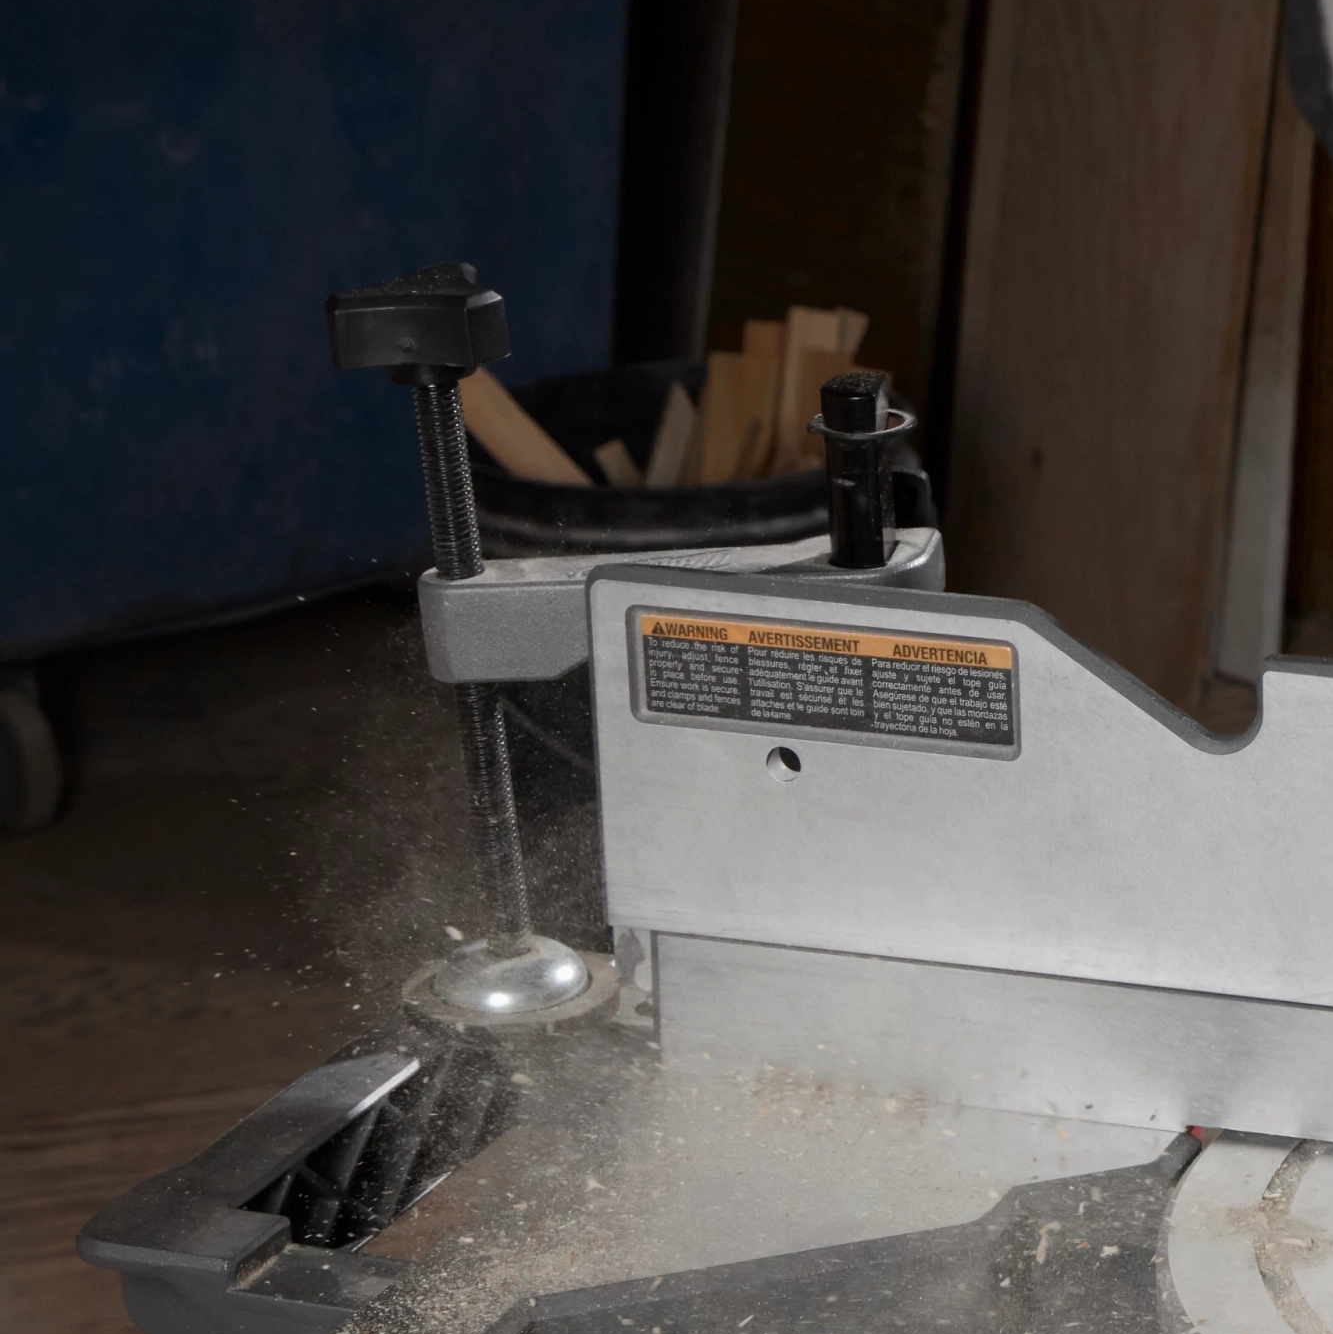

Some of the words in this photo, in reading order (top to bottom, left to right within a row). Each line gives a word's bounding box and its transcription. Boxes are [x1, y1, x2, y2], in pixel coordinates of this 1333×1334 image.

[665, 623, 728, 640] WARNING
[647, 637, 657, 646] To
[662, 639, 689, 649] reduce
[694, 641, 707, 650] the
[712, 643, 726, 652] risk
[730, 645, 739, 653] of
[748, 631, 859, 653] AVERTISSEMENT
[682, 651, 708, 662] adjust
[715, 654, 739, 664] fence
[748, 647, 767, 656] Pour
[771, 649, 799, 659] réduire
[803, 652, 815, 661] les
[818, 654, 848, 664] risques
[851, 656, 862, 665] de
[893, 644, 987, 665] ADVERTENCIA
[649, 660, 682, 671] properly
[689, 662, 704, 671] and
[712, 665, 739, 674] secure
[749, 657, 791, 670] blessures,
[798, 662, 822, 673] régler
[829, 665, 837, 673] et
[844, 666, 862, 675] fixer
[872, 659, 890, 668] Para
[893, 661, 920, 671] reducir
[922, 664, 929, 672] el
[931, 665, 956, 676] riesgo
[958, 667, 968, 676] de
[970, 668, 1006, 681] lesiones,
[649, 668, 656, 676] in
[663, 670, 685, 680] place
[691, 672, 716, 682] before
[723, 676, 740, 684] use.
[749, 668, 807, 680] adéquatement
[808, 673, 815, 681] le
[817, 674, 839, 684] guide
[841, 677, 863, 685] avant
[872, 669, 896, 680] ajuste
[904, 674, 909, 682] y
[916, 674, 940, 684] sujete
[948, 676, 955, 684] el
[963, 677, 981, 688] tope
[989, 680, 1006, 690] guía
[650, 678, 678, 688] Ensure
[681, 682, 699, 690] work
[702, 683, 708, 691] is
[711, 685, 740, 695] secure,
[796, 682, 834, 693] S'assurer
[838, 688, 853, 696] que
[856, 687, 863, 696] le
[873, 681, 931, 692] correctamente
[939, 686, 961, 695] antes
[969, 688, 979, 697] de
[651, 689, 665, 697] and
[667, 690, 696, 702] clamps
[698, 693, 712, 701] and
[714, 694, 741, 704] fences
[750, 688, 774, 698] travail
[780, 691, 792, 699] est
[799, 693, 832, 703] sécurisé
[839, 696, 846, 704] et
[852, 697, 864, 706] les
[873, 689, 916, 701] Asegúrese
[919, 693, 929, 702] de
[932, 697, 947, 705] que
[950, 697, 956, 705] el
[960, 697, 987, 710] trabajo
[990, 701, 1007, 710] esté
[666, 700, 685, 709] clear
[687, 702, 696, 710] of
[697, 702, 720, 712] blade.
[751, 699, 784, 709] attaches
[787, 702, 795, 710] et
[797, 702, 804, 711] le
[807, 704, 828, 714] guide
[831, 707, 848, 715] sont
[850, 707, 864, 716] loin
[751, 708, 761, 716] de
[763, 709, 770, 717] la
[873, 699, 890, 709] bien
[893, 702, 929, 714] sujetado,
[931, 707, 935, 715] y
[937, 707, 952, 716] que
[954, 707, 966, 716] las
[968, 710, 1007, 720] mordazas
[874, 711, 878, 720] y
[884, 711, 891, 719] el
[896, 712, 914, 723] tope
[919, 715, 937, 724] guía
[958, 718, 980, 727] estén
[1001, 722, 1008, 730] la
[875, 720, 916, 731] trayectoria
[918, 724, 928, 732] de
[930, 725, 937, 733] la
[939, 726, 958, 737] hoja.
